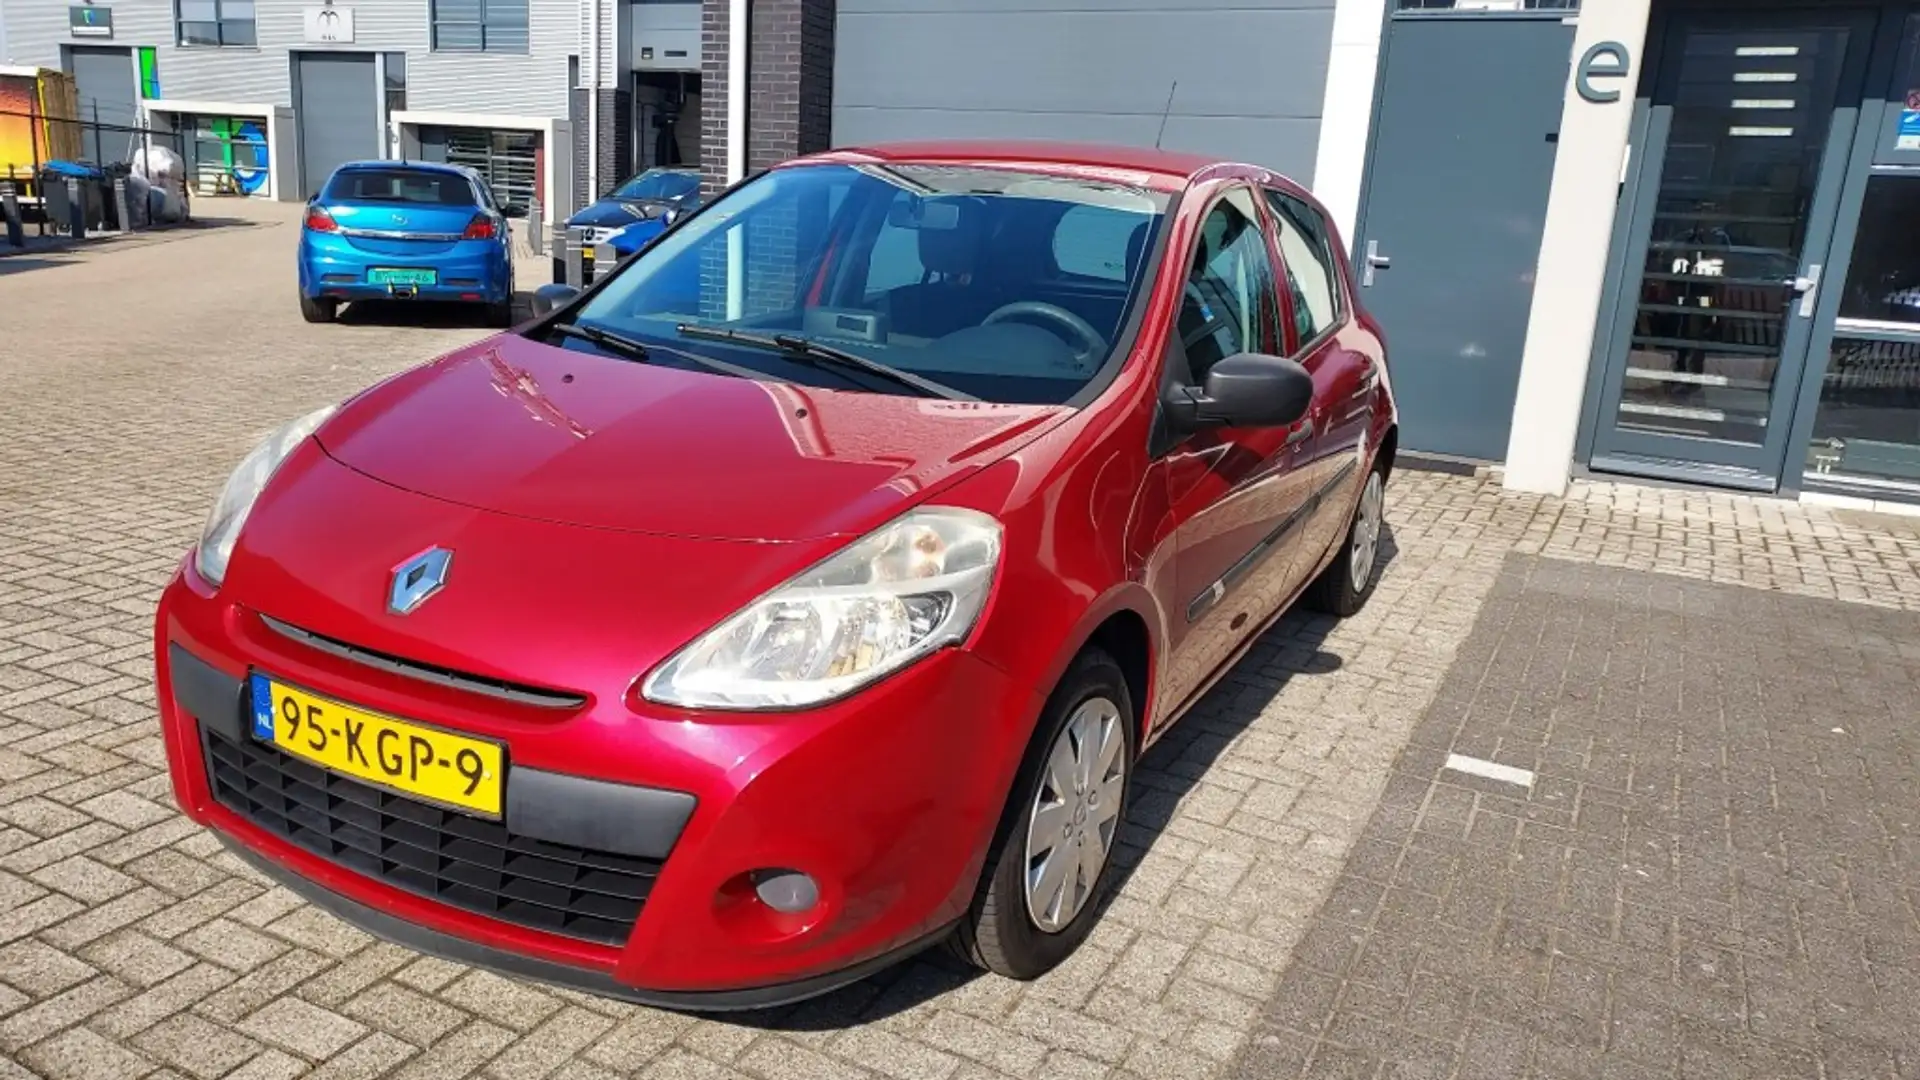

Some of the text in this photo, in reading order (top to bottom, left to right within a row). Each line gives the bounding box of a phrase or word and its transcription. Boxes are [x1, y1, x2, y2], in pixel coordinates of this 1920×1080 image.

[1576, 41, 1630, 103] e
[257, 712, 273, 730] NL
[282, 696, 483, 796] 95-KGP-9
